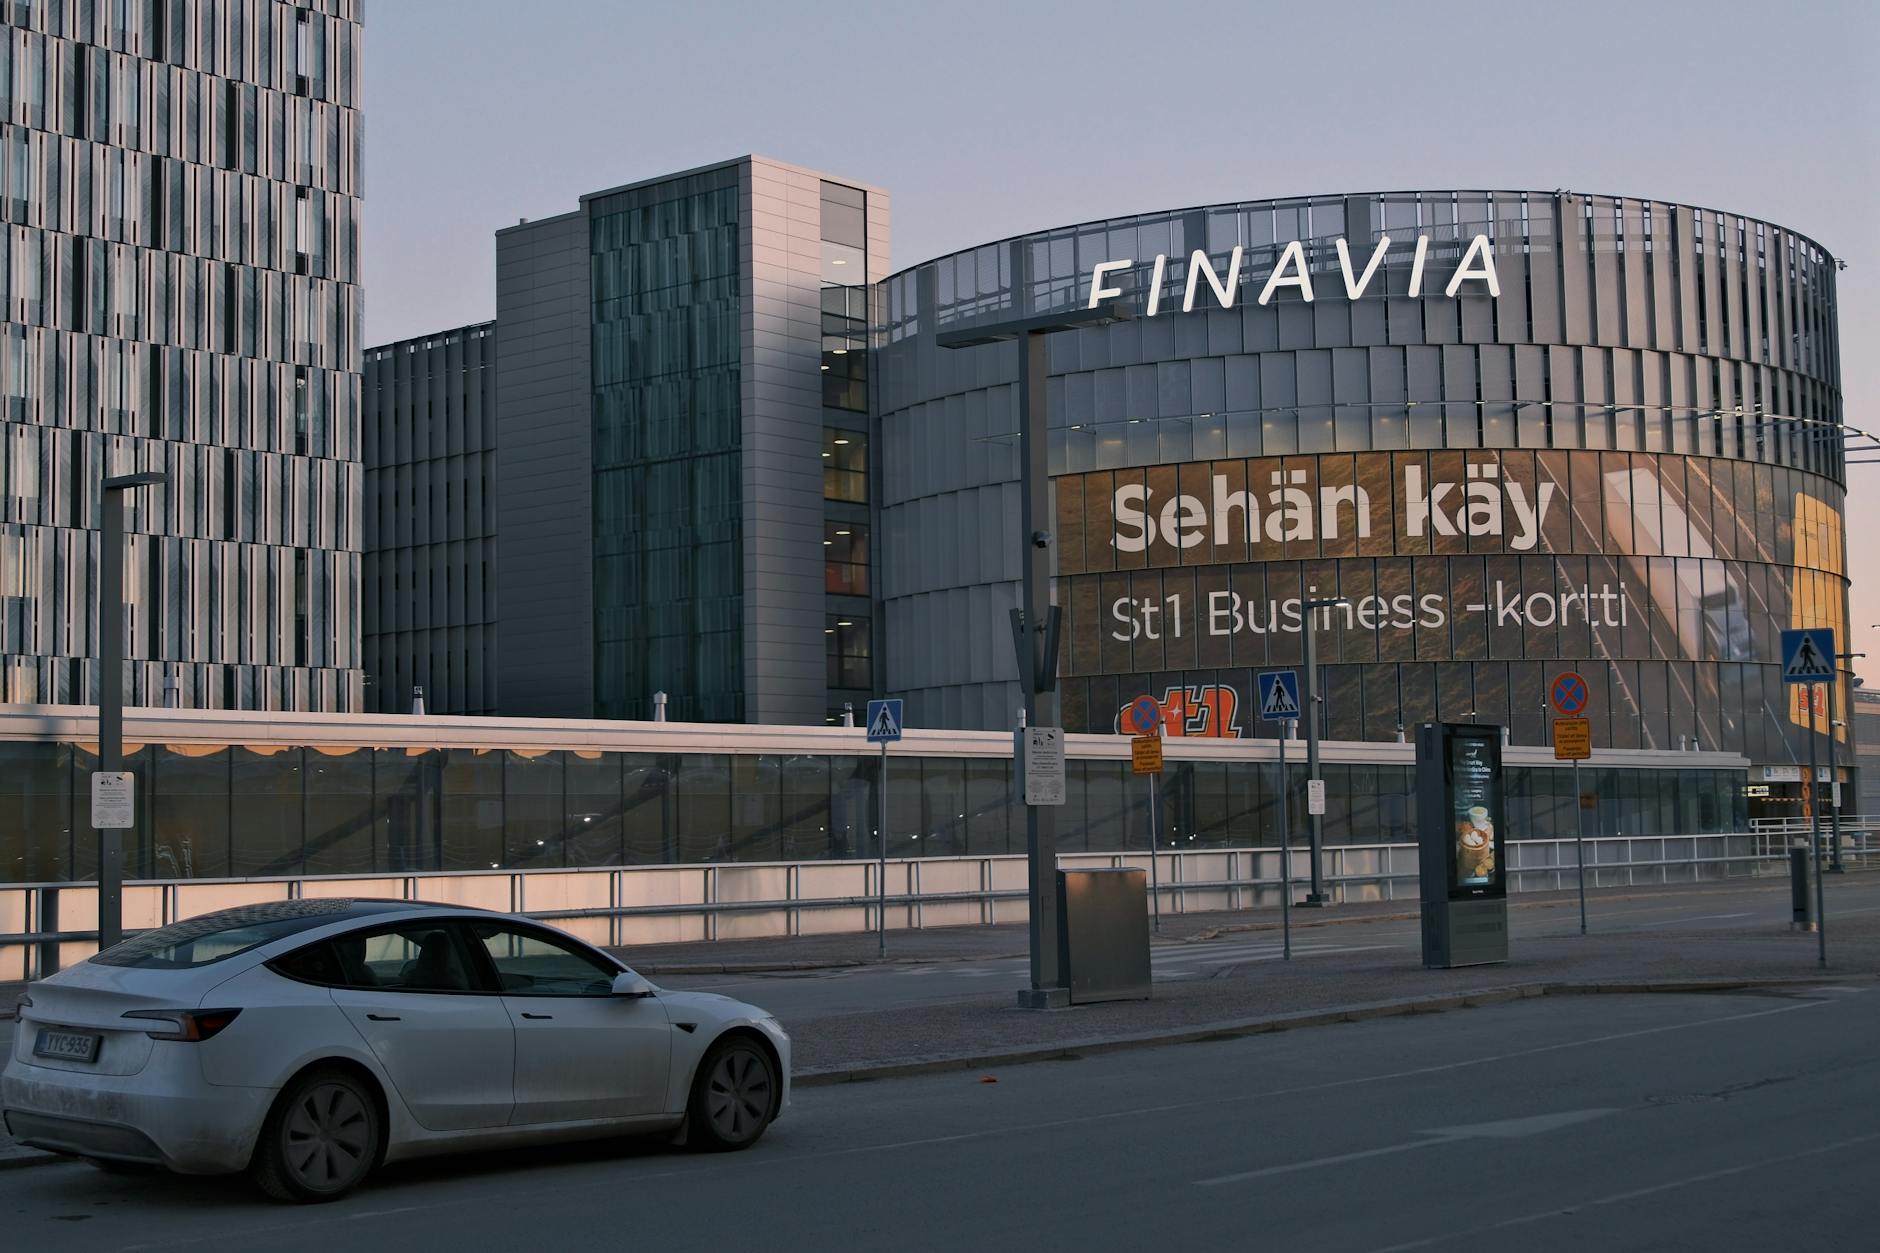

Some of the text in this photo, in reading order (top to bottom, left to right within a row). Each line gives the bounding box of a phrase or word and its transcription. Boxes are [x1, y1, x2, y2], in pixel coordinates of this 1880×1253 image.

[1088, 233, 1501, 317] FINAVIA
[1109, 464, 1555, 552] Sehän käy
[1111, 580, 1628, 642] St1 Business -kortti
